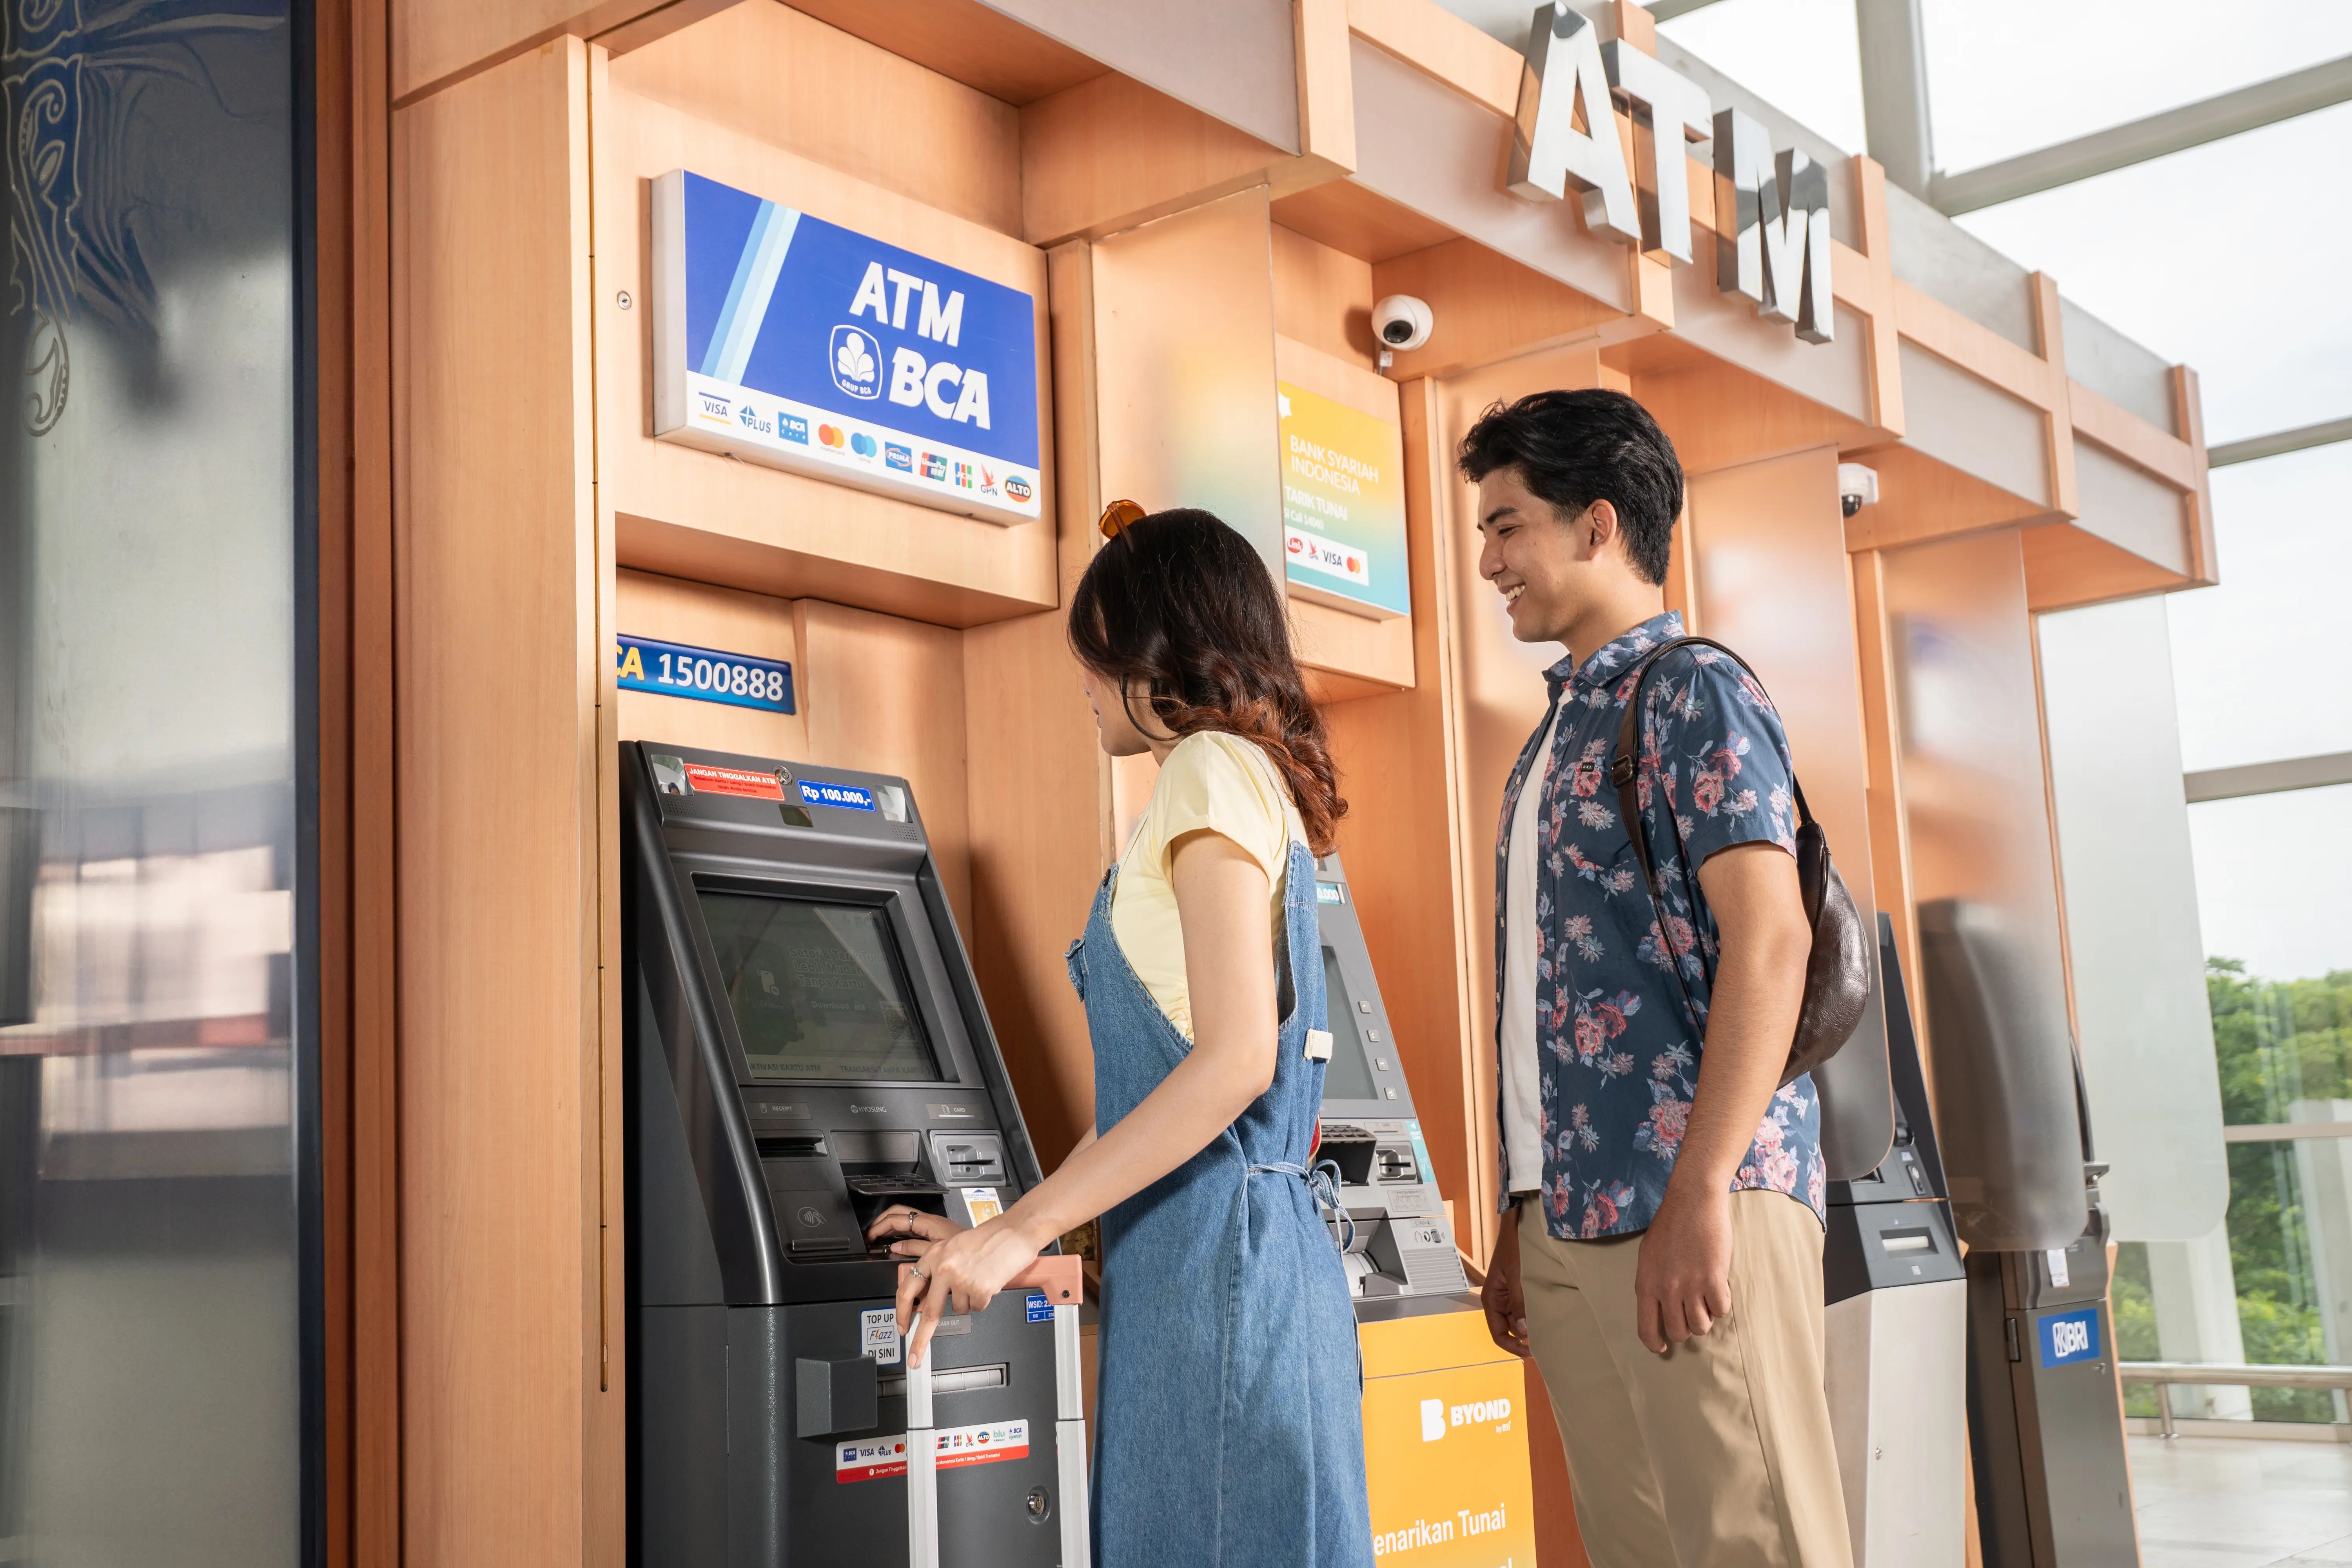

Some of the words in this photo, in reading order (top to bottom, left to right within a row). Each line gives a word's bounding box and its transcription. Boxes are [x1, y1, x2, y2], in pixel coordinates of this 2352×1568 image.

[1507, 0, 1834, 345] ATM
[849, 261, 964, 347] ATM
[842, 379, 858, 393] GRUP
[860, 387, 872, 395] BCA
[889, 347, 991, 430] BCA
[703, 400, 728, 417] VISA
[748, 417, 771, 433] PLUS
[789, 420, 805, 432] BCA
[820, 445, 845, 456] mastercard
[888, 452, 910, 463] PRIMA
[1290, 434, 1326, 464] BANK
[1328, 450, 1378, 484] SYARIAH
[1291, 455, 1361, 496] INDONESIA
[981, 486, 998, 496] GPN
[1006, 481, 1031, 497] ALTO
[1284, 485, 1315, 510] TARIK
[1316, 496, 1348, 521] TUNAI
[1323, 549, 1342, 567] VISA
[658, 653, 783, 701] 1500888
[690, 768, 717, 778] JANGAN
[717, 771, 761, 783] TINGGALKAN
[802, 785, 819, 800] Rp
[821, 788, 871, 806] 100.000,-
[788, 945, 821, 959] Setor
[793, 960, 824, 973] Lebih
[825, 962, 865, 975] Mudah
[796, 974, 832, 990] Tanpa
[833, 976, 865, 990] Kartu
[811, 1000, 849, 1009] Download
[867, 1314, 881, 1324] TOP
[884, 1314, 894, 1322] UP
[2066, 1321, 2089, 1353] BRI
[879, 1348, 894, 1358] SINI
[1450, 1398, 1511, 1426] BYOND
[1496, 1425, 1502, 1433] by
[1502, 1420, 1511, 1432] BSI
[860, 1448, 874, 1457] VISA
[1457, 1503, 1506, 1538] Tunai
